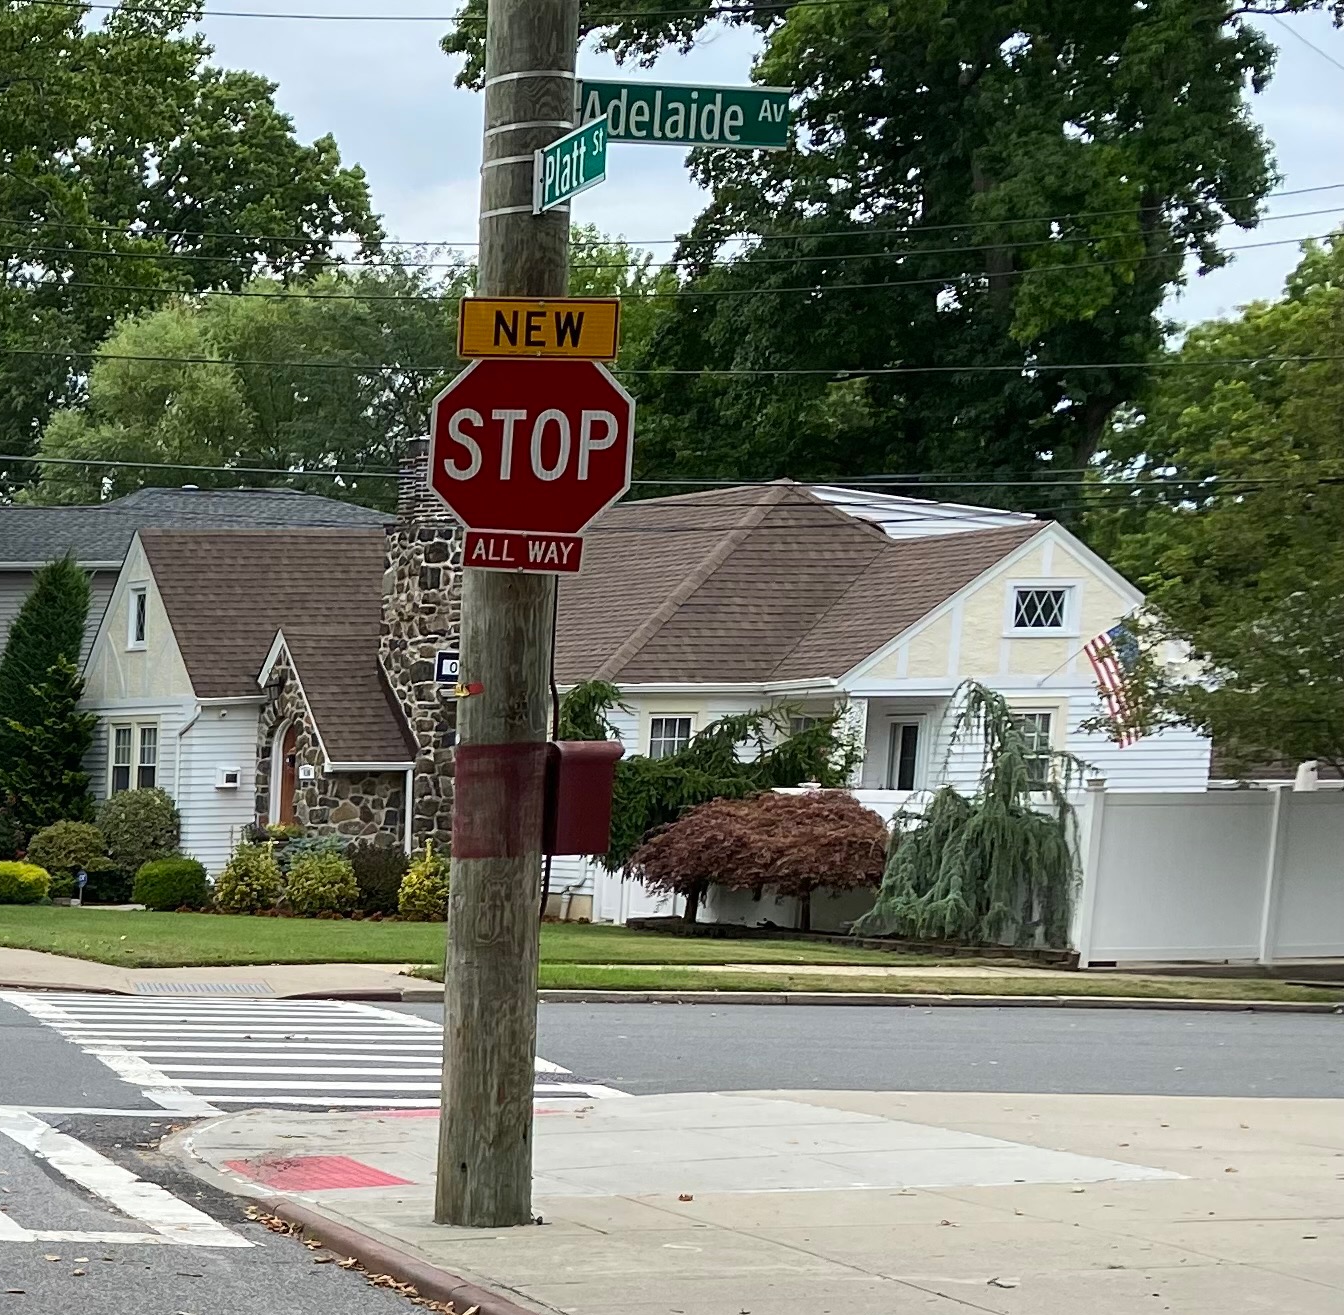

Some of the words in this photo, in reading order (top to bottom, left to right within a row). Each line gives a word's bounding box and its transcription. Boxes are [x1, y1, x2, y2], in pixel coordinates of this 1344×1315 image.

[581, 88, 744, 141] Adelaide
[758, 99, 786, 122] Av
[544, 139, 587, 202] Platt
[592, 129, 604, 156] St
[493, 310, 585, 348] NEW
[444, 408, 619, 481] STOP
[472, 539, 515, 561] ALL
[528, 541, 574, 564] WAY
